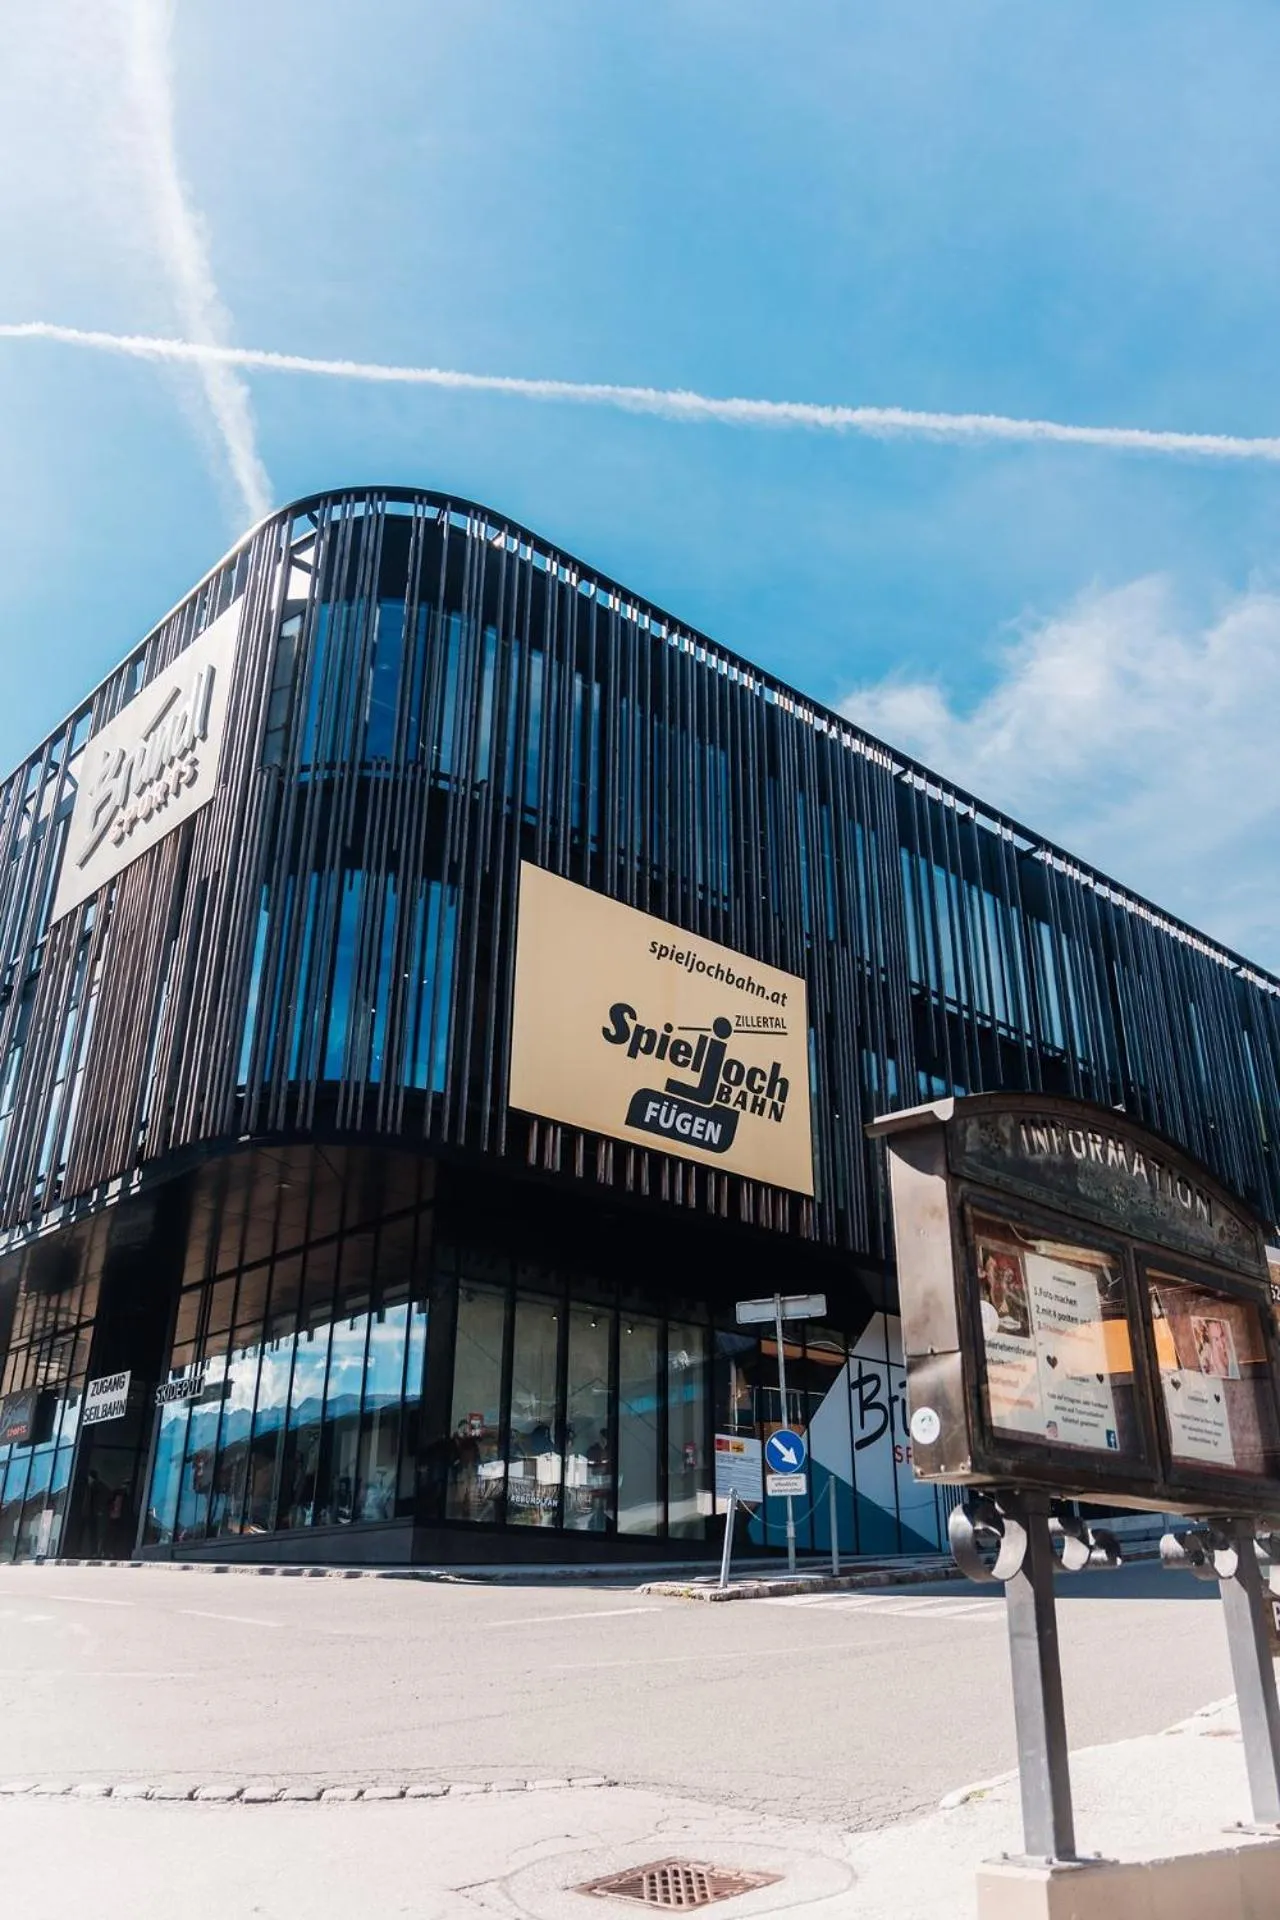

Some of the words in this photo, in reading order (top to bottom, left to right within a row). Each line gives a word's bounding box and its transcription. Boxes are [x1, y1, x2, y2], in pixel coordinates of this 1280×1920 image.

[109, 757, 199, 848] SPORTS
[649, 940, 788, 1007] spieljochbahn.at
[735, 1014, 787, 1030] ZILLERTAL
[602, 1002, 789, 1106] Spieljoch
[643, 1101, 722, 1145] FÜGEN
[716, 1082, 785, 1123] BAHN
[1020, 1119, 1213, 1227] INFORMATION
[91, 1374, 126, 1397] ZUGANG
[156, 1375, 205, 1405] SKIDEPOT
[83, 1400, 125, 1423] SEILBAHN
